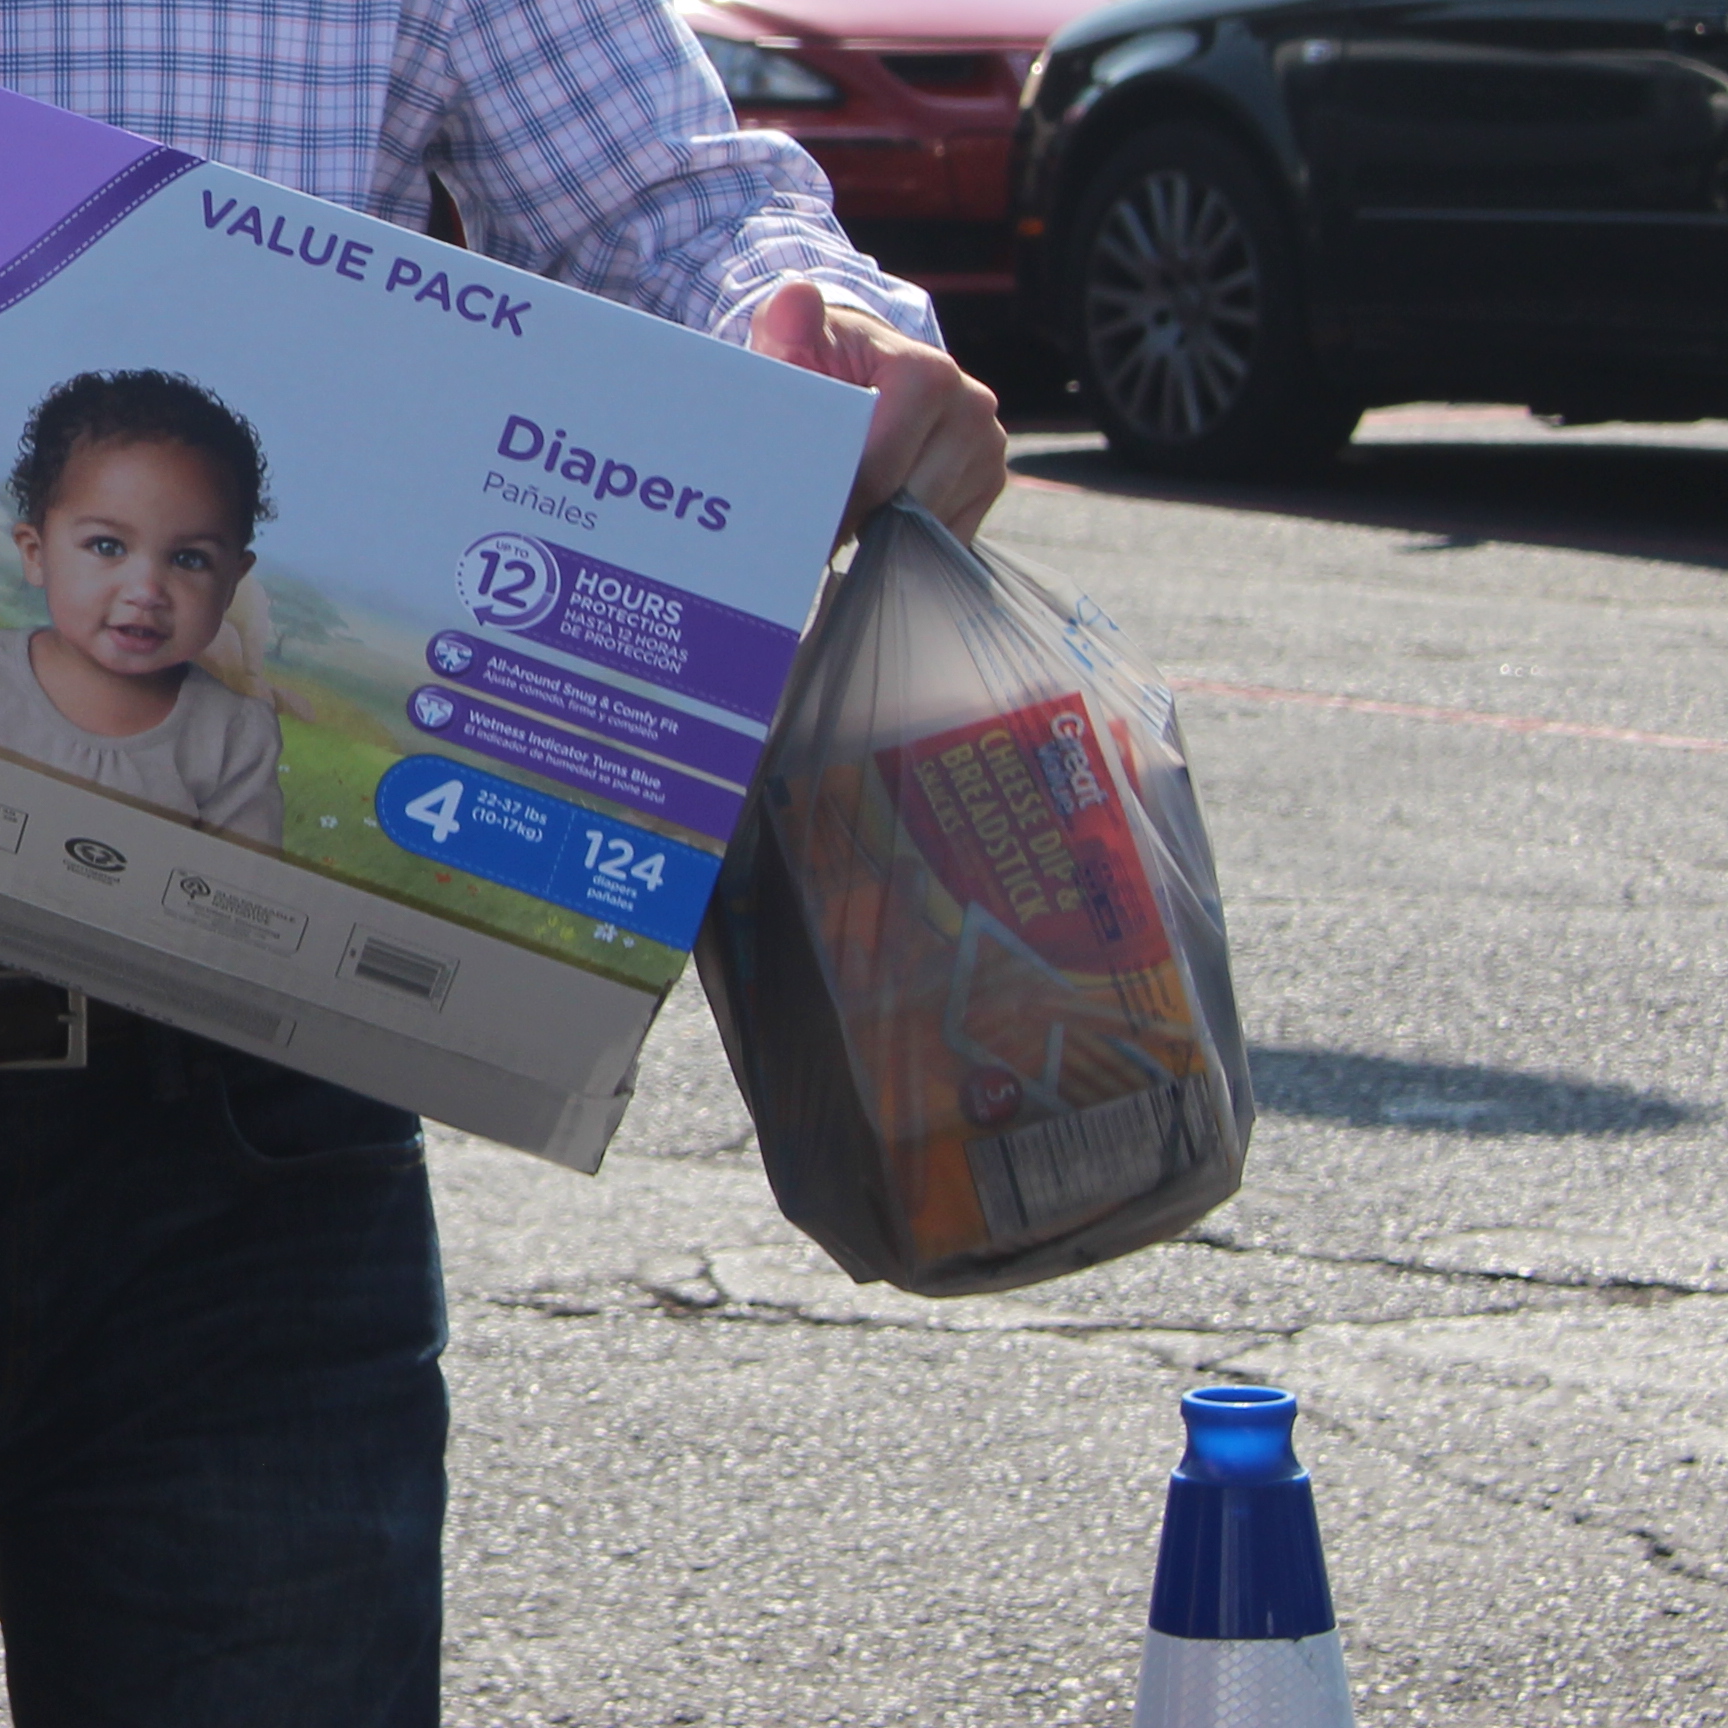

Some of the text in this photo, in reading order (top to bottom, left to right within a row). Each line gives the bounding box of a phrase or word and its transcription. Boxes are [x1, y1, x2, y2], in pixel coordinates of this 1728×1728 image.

[202, 190, 532, 337] VALUE PACK
[482, 471, 599, 531] Pañales
[496, 414, 733, 533] Diapers
[496, 540, 528, 559] UP TO
[478, 551, 683, 625] 12 HOURS
[570, 592, 682, 642] PROTECTION
[560, 622, 580, 639] DE
[564, 608, 689, 663] HASTA 12 HORAS
[487, 656, 680, 735] All-Around Snug & Comfy Fit
[469, 710, 661, 789] Wetness Indicator Turns Blue
[529, 746, 545, 760] de
[642, 786, 666, 804] azul
[405, 779, 548, 843] 4 22-37 lbs
[472, 806, 544, 843] (10-17kg)
[940, 741, 1051, 925] BREADSTICK
[979, 729, 1050, 831] CHEESE
[1029, 829, 1075, 881] DIP
[584, 830, 666, 892] 124
[593, 874, 638, 899] diapers
[587, 888, 634, 912] pañales
